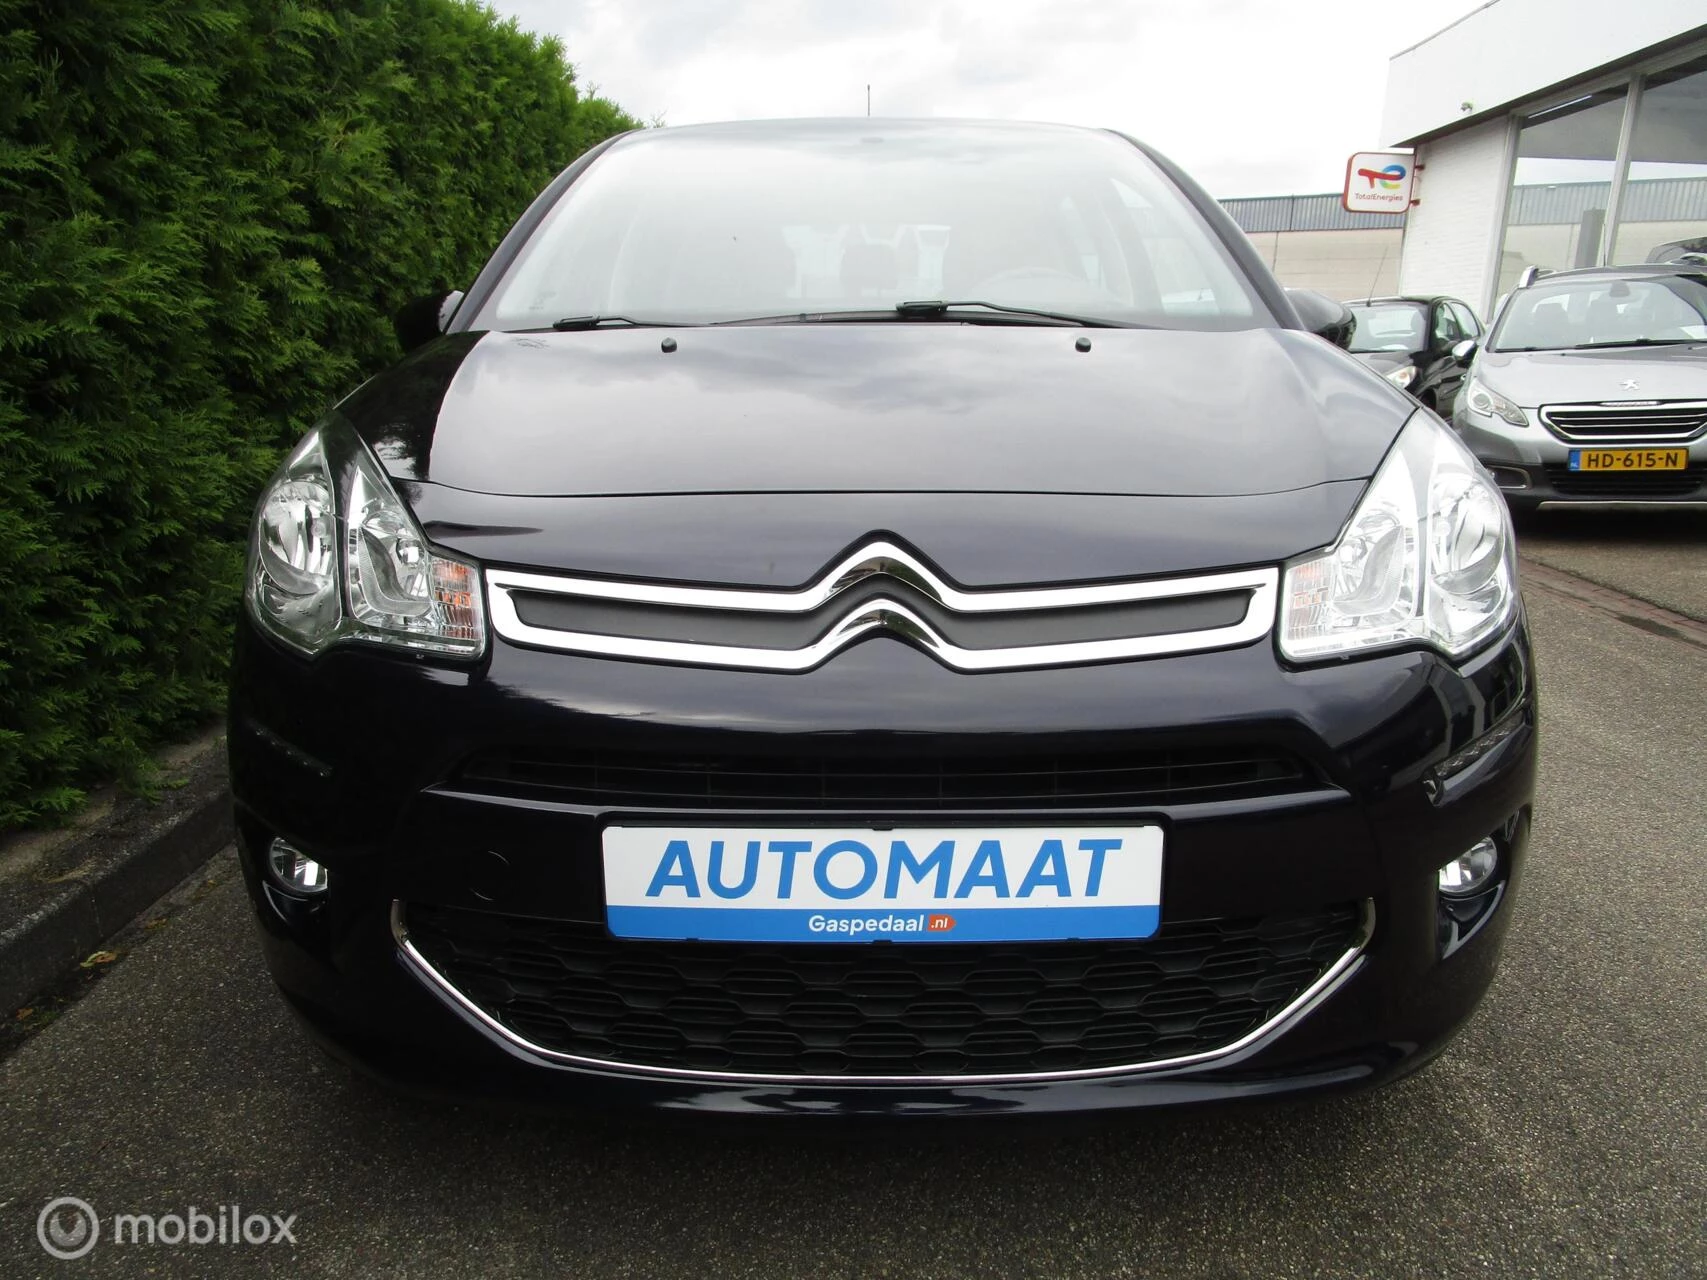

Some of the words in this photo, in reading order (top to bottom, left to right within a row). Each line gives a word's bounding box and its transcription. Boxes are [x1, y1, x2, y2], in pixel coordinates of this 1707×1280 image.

[1354, 192, 1404, 202] TotalEnergies
[1587, 452, 1678, 468] HD-615-N
[645, 839, 1123, 901] AUTOMAAT
